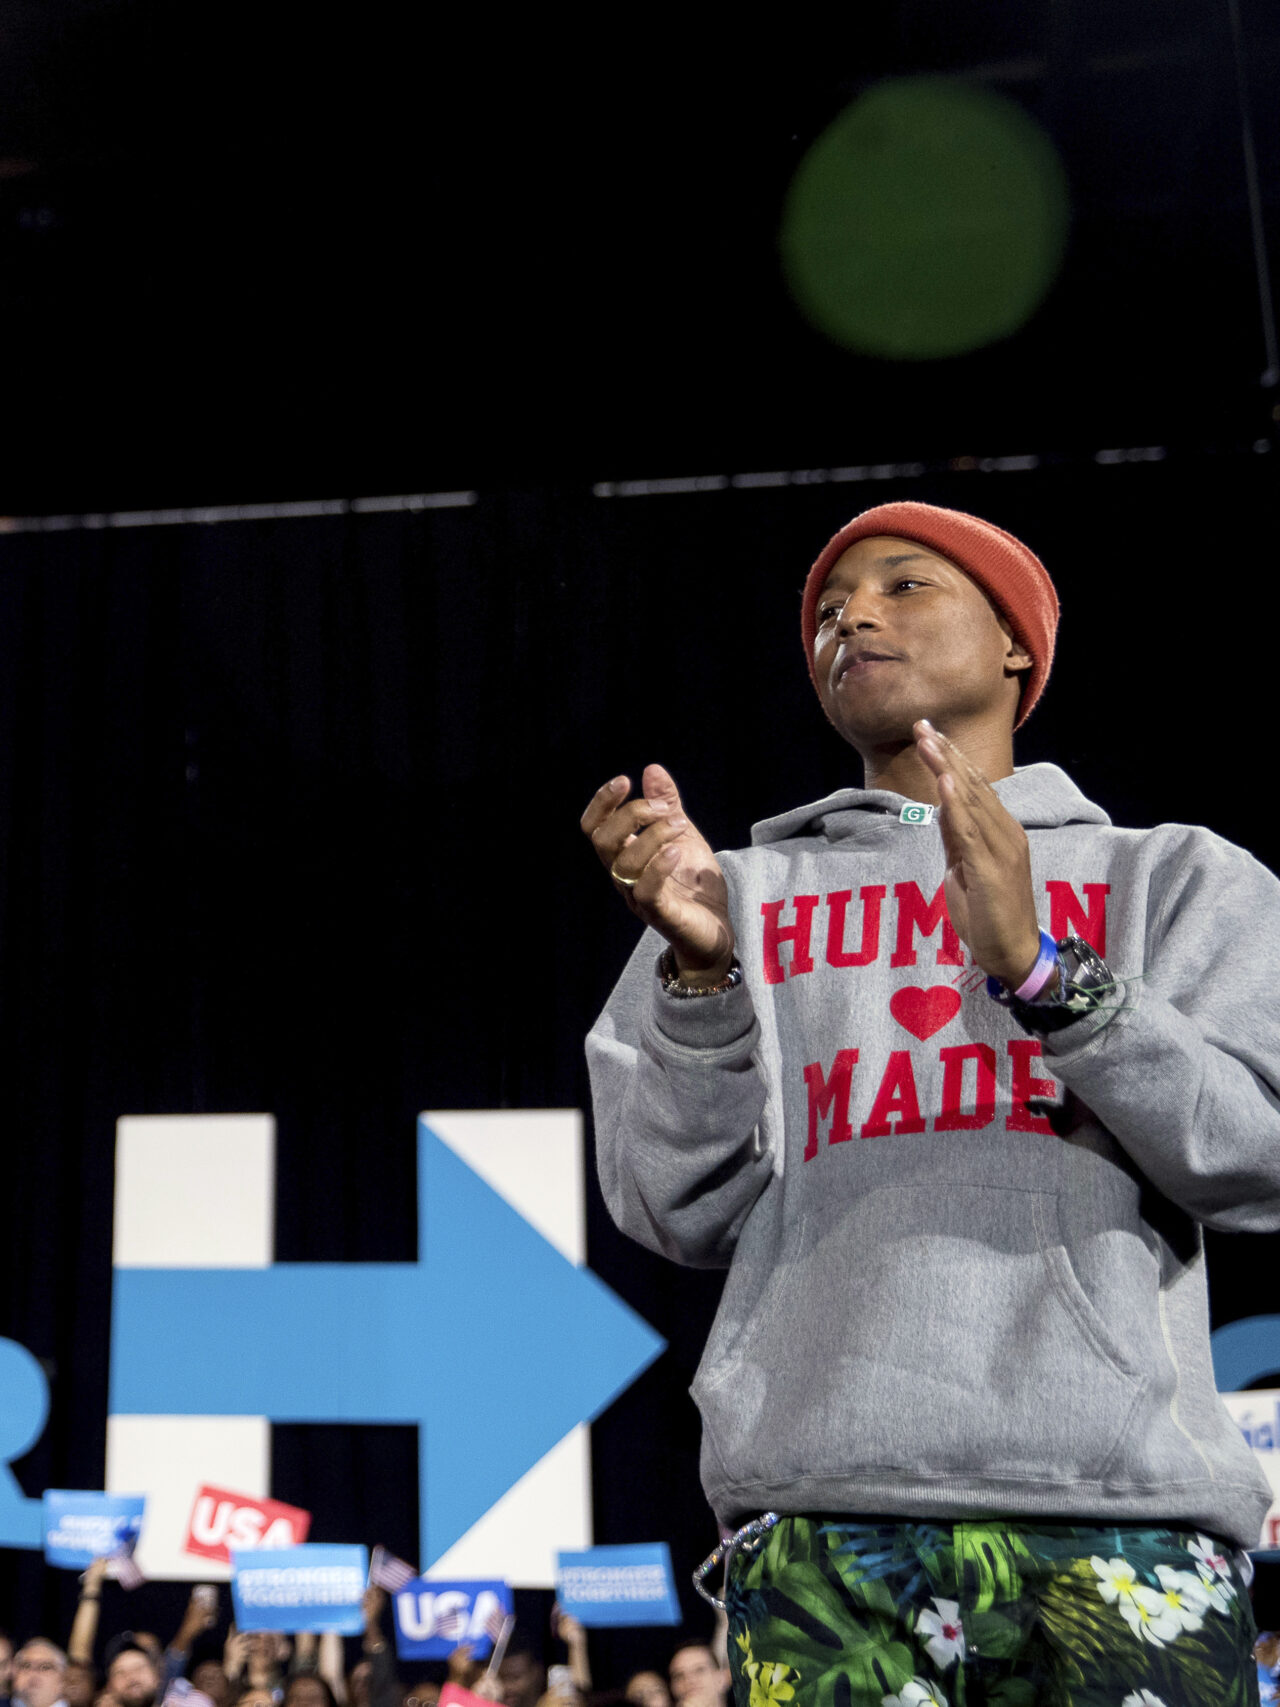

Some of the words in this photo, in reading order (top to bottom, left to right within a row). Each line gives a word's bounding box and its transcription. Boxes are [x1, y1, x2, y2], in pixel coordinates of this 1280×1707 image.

[761, 879, 1111, 985] HUMN
[803, 1039, 1057, 1162] MADE
[191, 1496, 297, 1551] USA
[397, 1590, 501, 1641] USA
